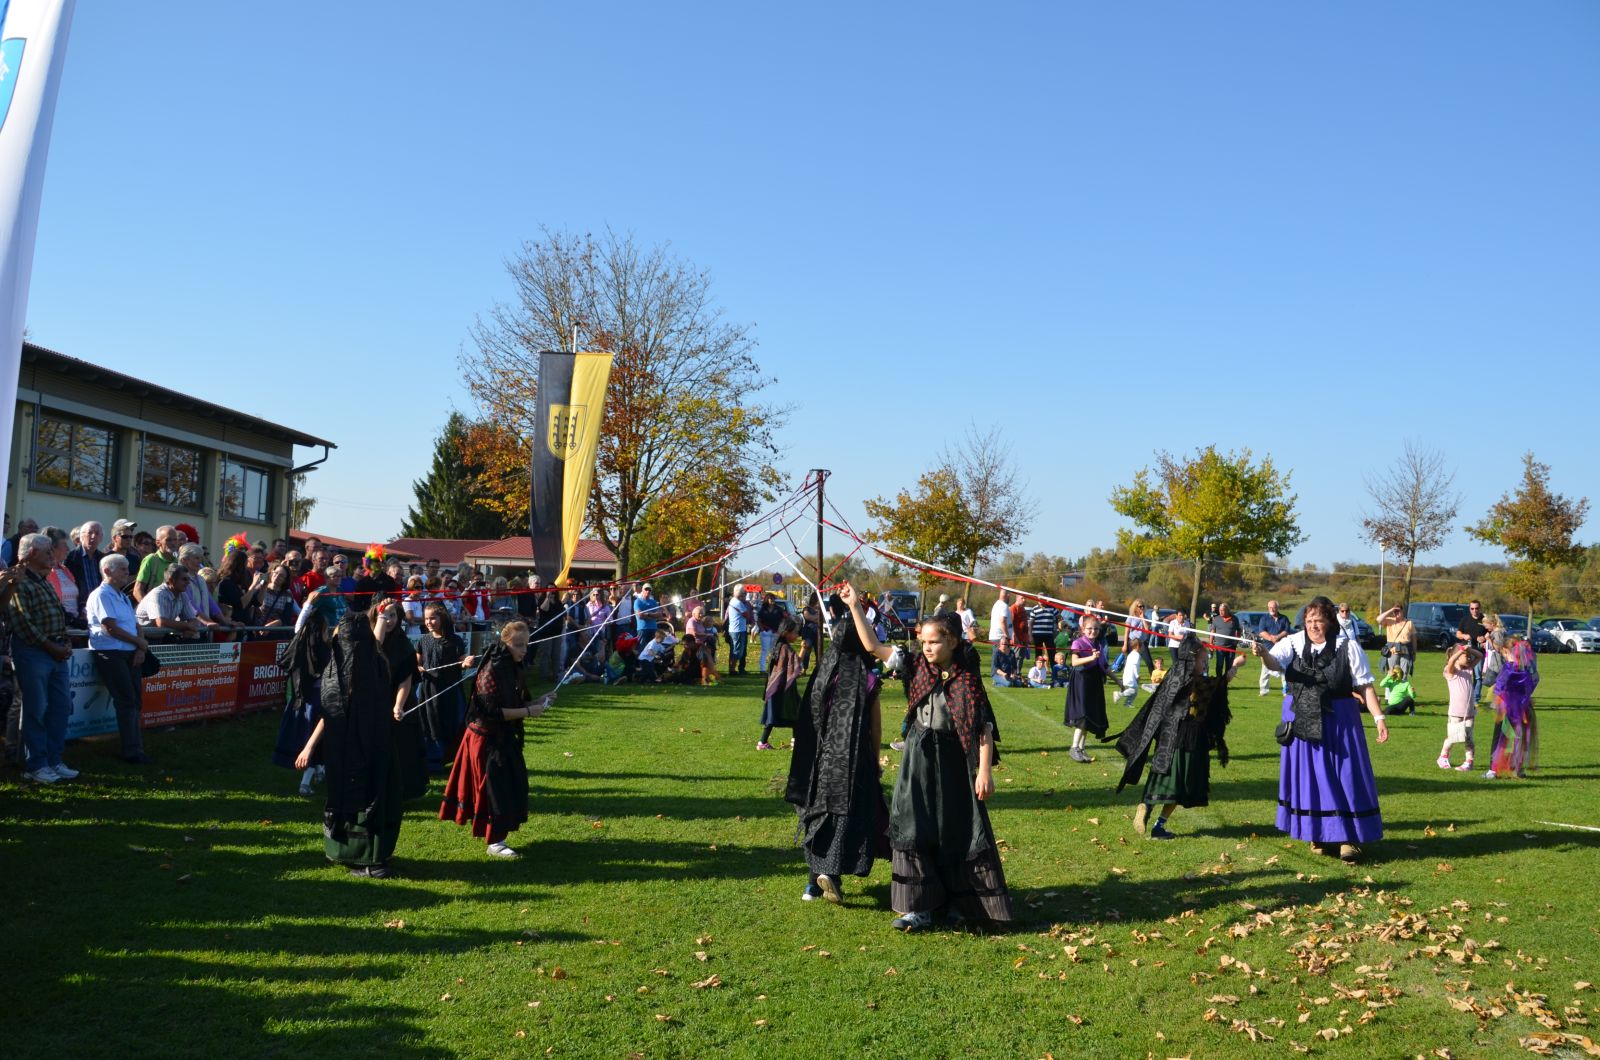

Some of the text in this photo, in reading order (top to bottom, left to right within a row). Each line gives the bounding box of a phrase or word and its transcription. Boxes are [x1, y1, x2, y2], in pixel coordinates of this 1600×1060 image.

[183, 668, 197, 676] man
[197, 666, 212, 675] beim
[145, 681, 167, 693] Reifen
[171, 679, 193, 691] Felgen
